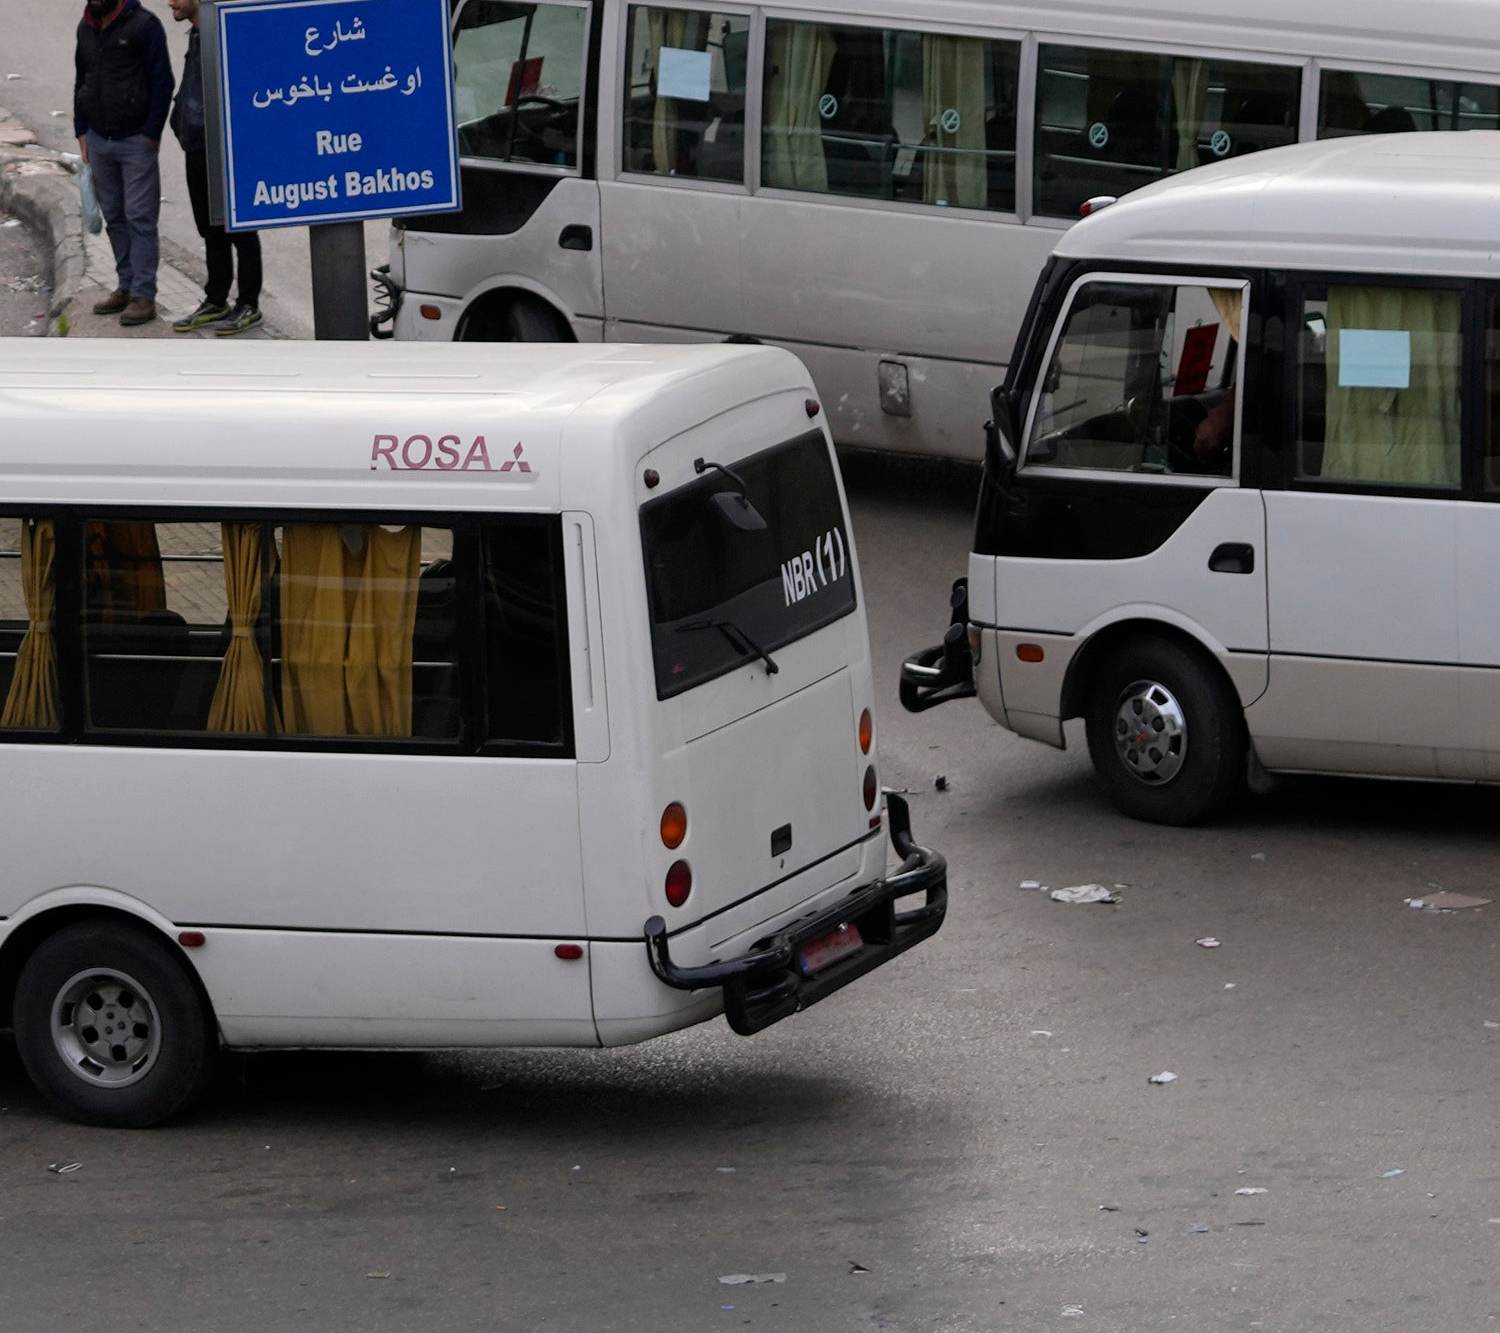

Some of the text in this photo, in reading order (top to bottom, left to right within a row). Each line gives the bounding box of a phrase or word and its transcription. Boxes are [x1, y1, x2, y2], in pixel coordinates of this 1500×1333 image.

[304, 16, 366, 57] شارع
[252, 74, 333, 109] باخوس
[316, 130, 363, 156] Rue
[253, 166, 435, 210] August Bakhos
[370, 434, 492, 471] ROSA
